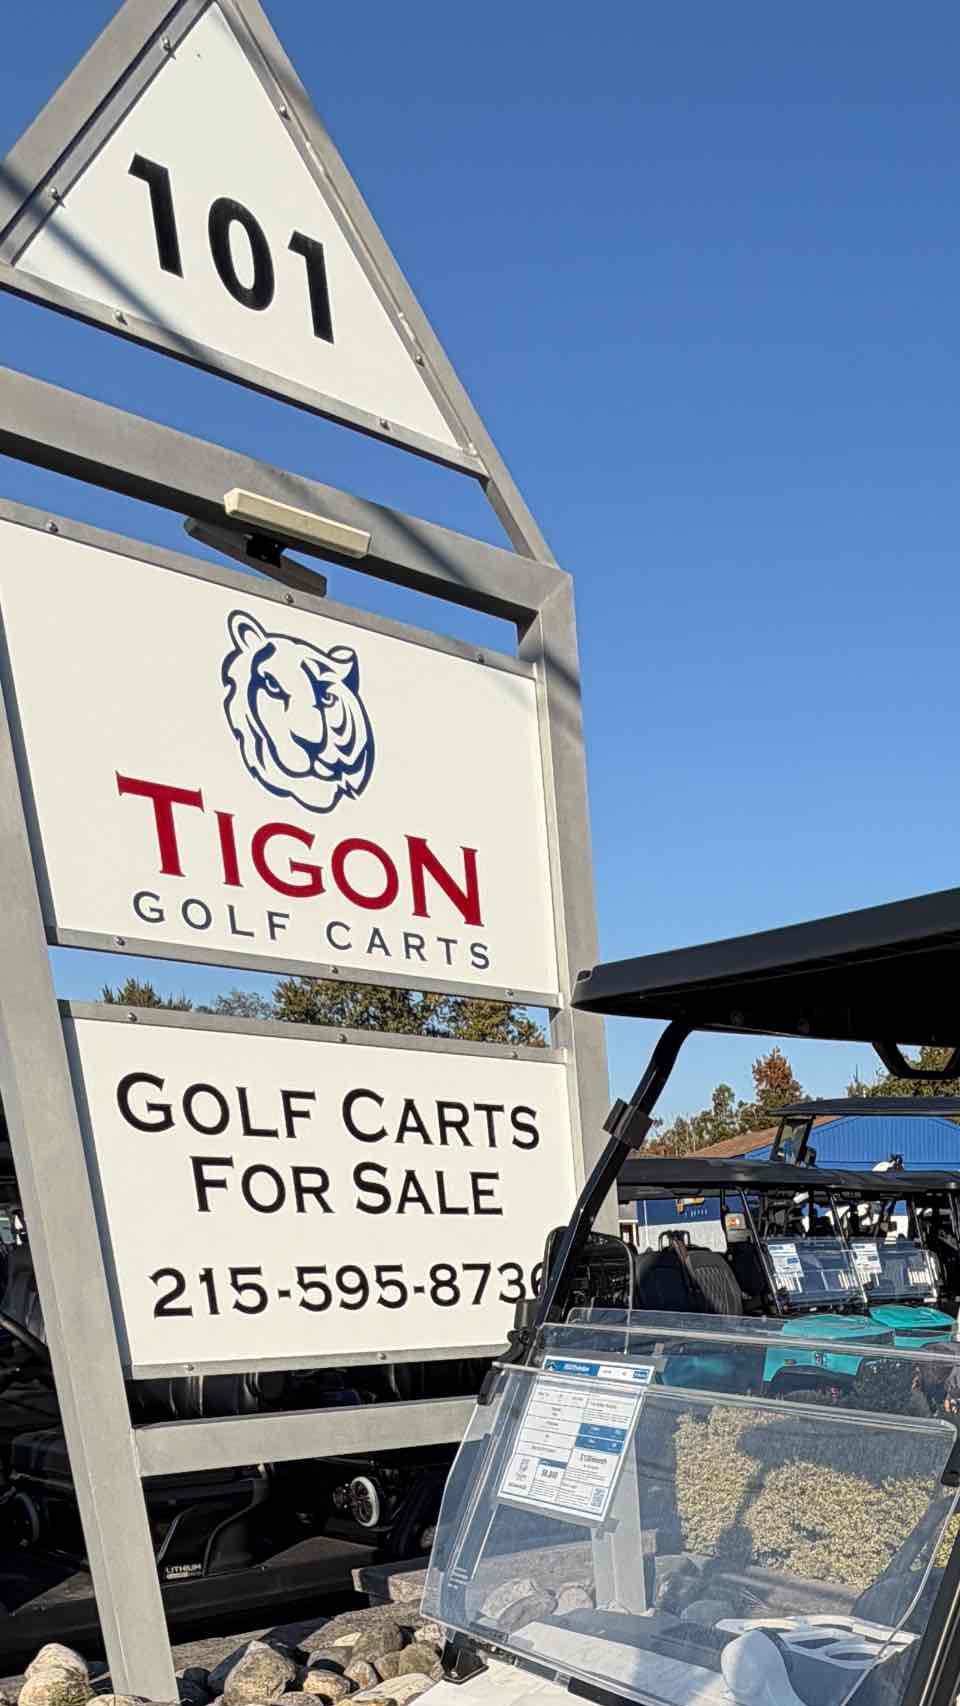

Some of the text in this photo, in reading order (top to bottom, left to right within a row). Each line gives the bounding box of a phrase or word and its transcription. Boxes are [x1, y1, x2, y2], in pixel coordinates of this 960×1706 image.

[128, 153, 335, 345] 101
[115, 771, 485, 927] TIGON
[133, 891, 491, 970] GOLF CARTS
[116, 1072, 540, 1150] GOLF CARTS
[190, 1155, 504, 1216] FOR SALE
